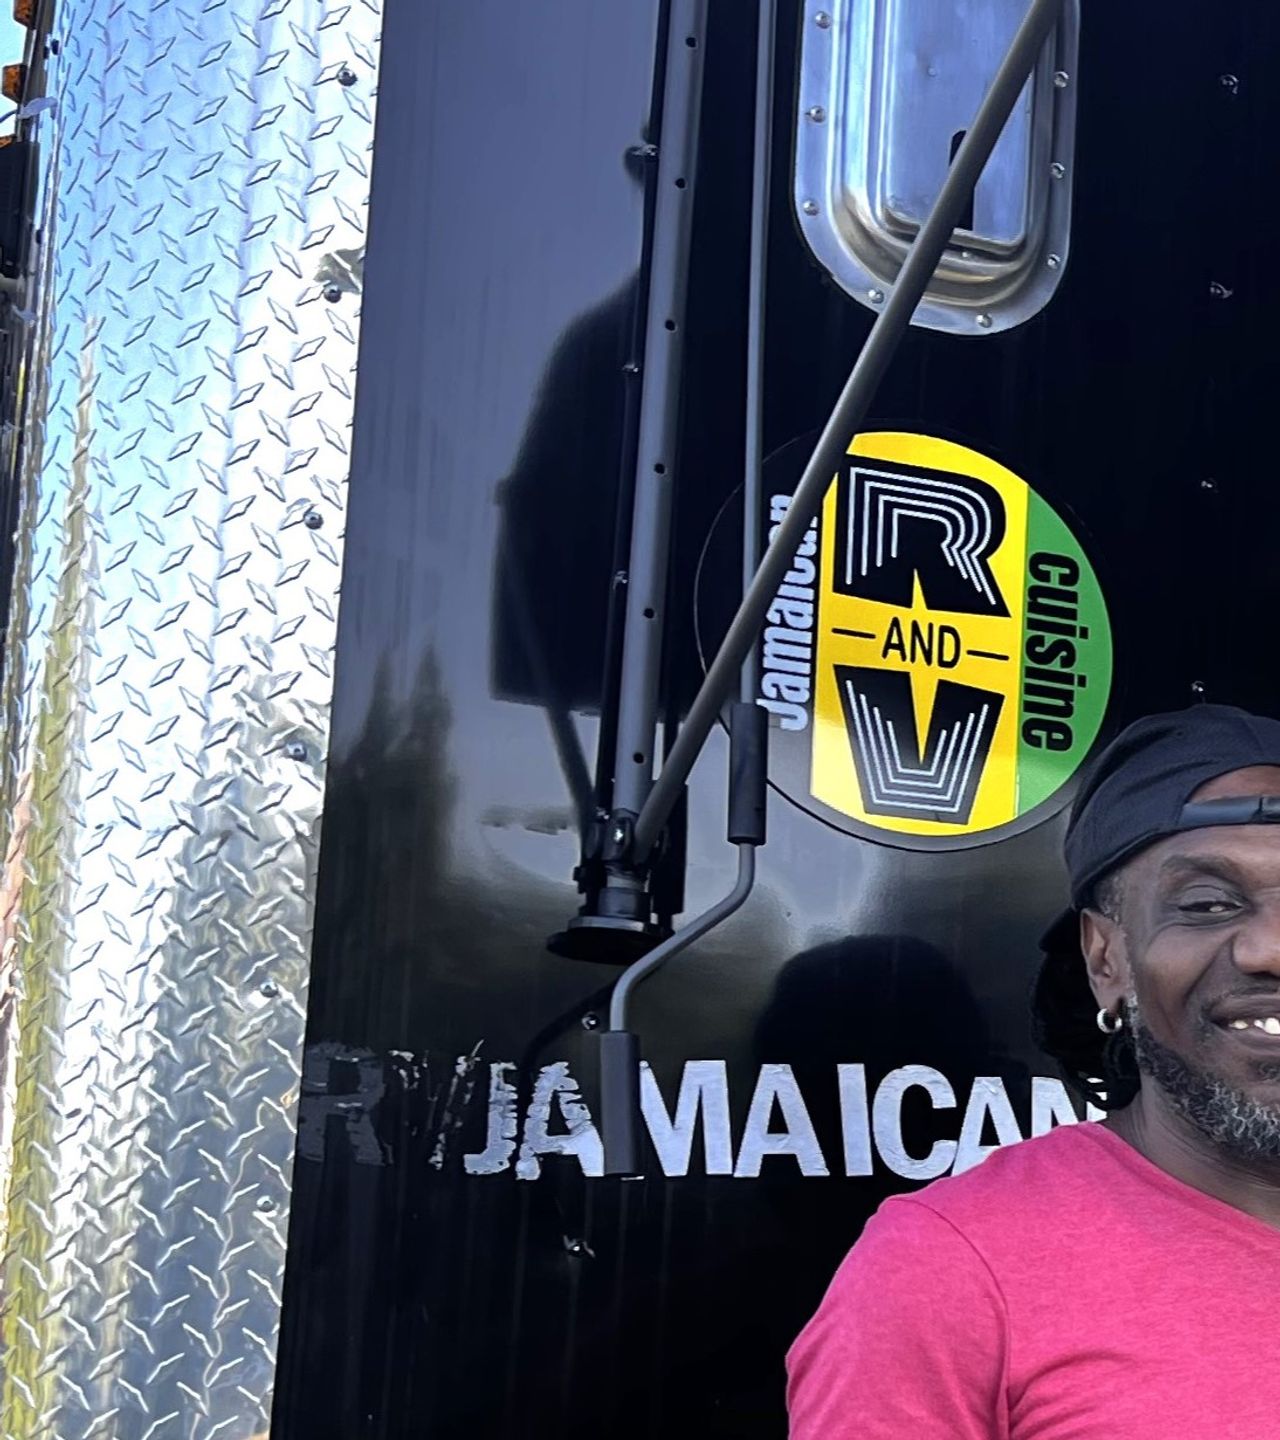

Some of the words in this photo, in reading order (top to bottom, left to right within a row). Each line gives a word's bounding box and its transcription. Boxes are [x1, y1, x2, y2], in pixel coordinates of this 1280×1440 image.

[831, 453, 1012, 618] R
[881, 616, 962, 669] AND
[832, 663, 1006, 826] V
